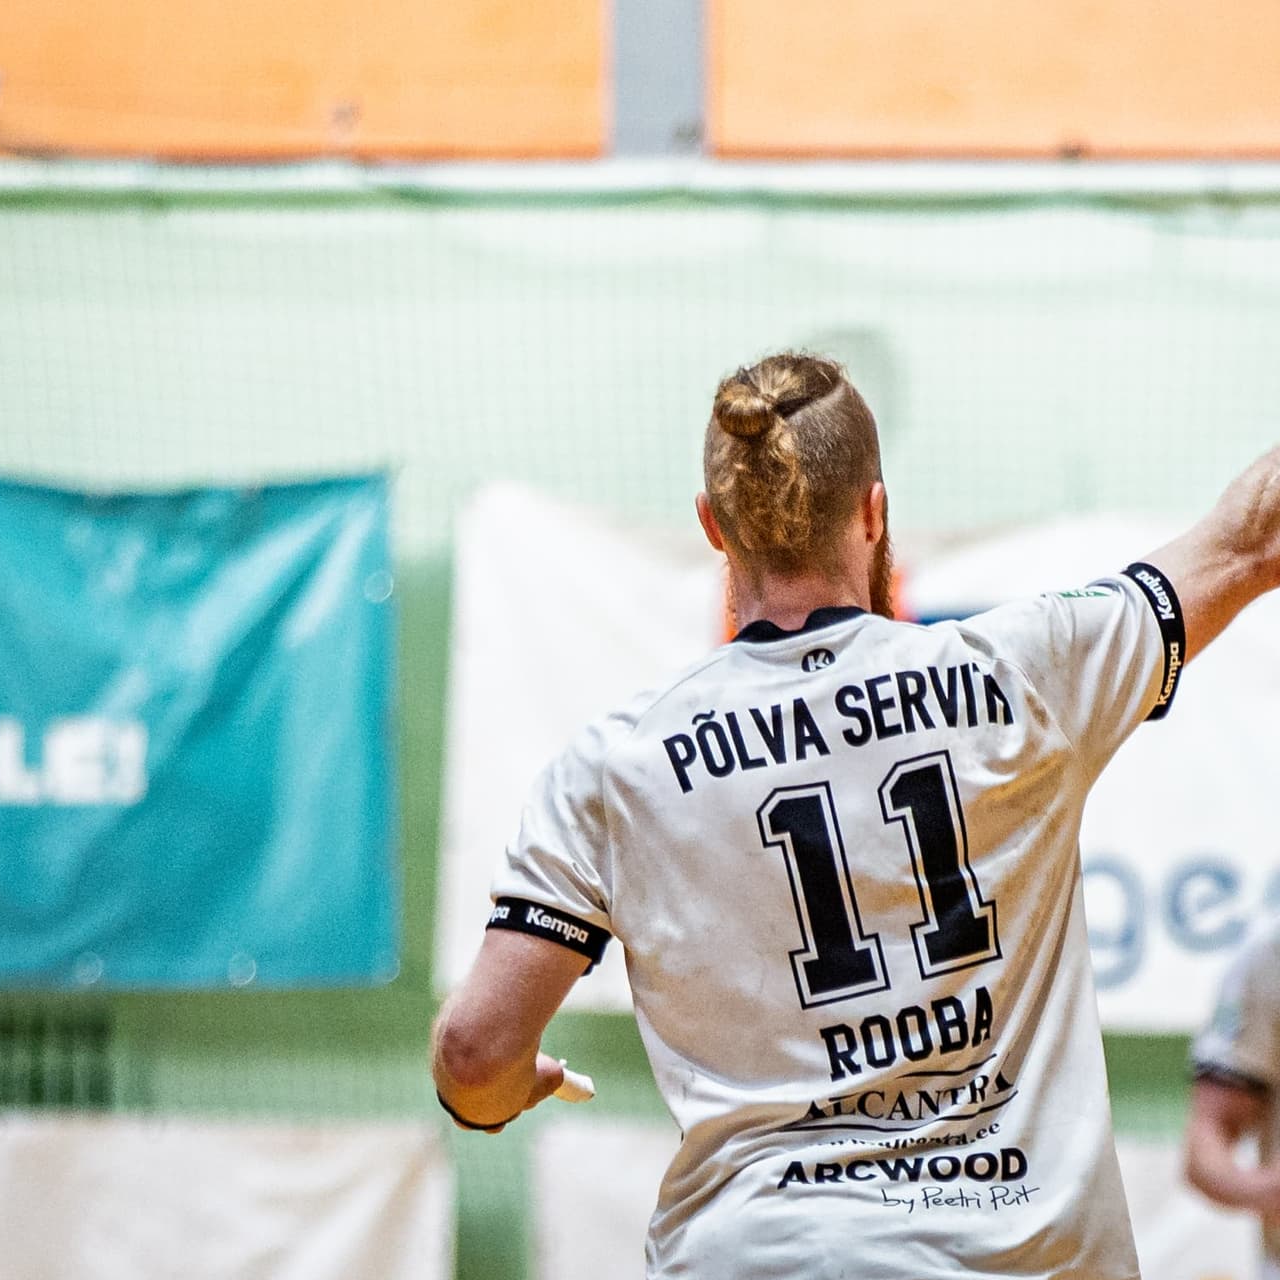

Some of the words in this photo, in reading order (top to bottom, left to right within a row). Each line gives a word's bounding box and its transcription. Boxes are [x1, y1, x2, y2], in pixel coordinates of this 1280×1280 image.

[1135, 570, 1175, 620] Kempa
[1157, 642, 1181, 705] Kempa
[662, 697, 831, 794] PÕLVA
[757, 749, 1003, 1010] 11
[526, 905, 589, 944] Kempa
[820, 986, 994, 1081] ROOBA
[777, 1147, 1028, 1190] ARCWOOD
[881, 1187, 920, 1213] by
